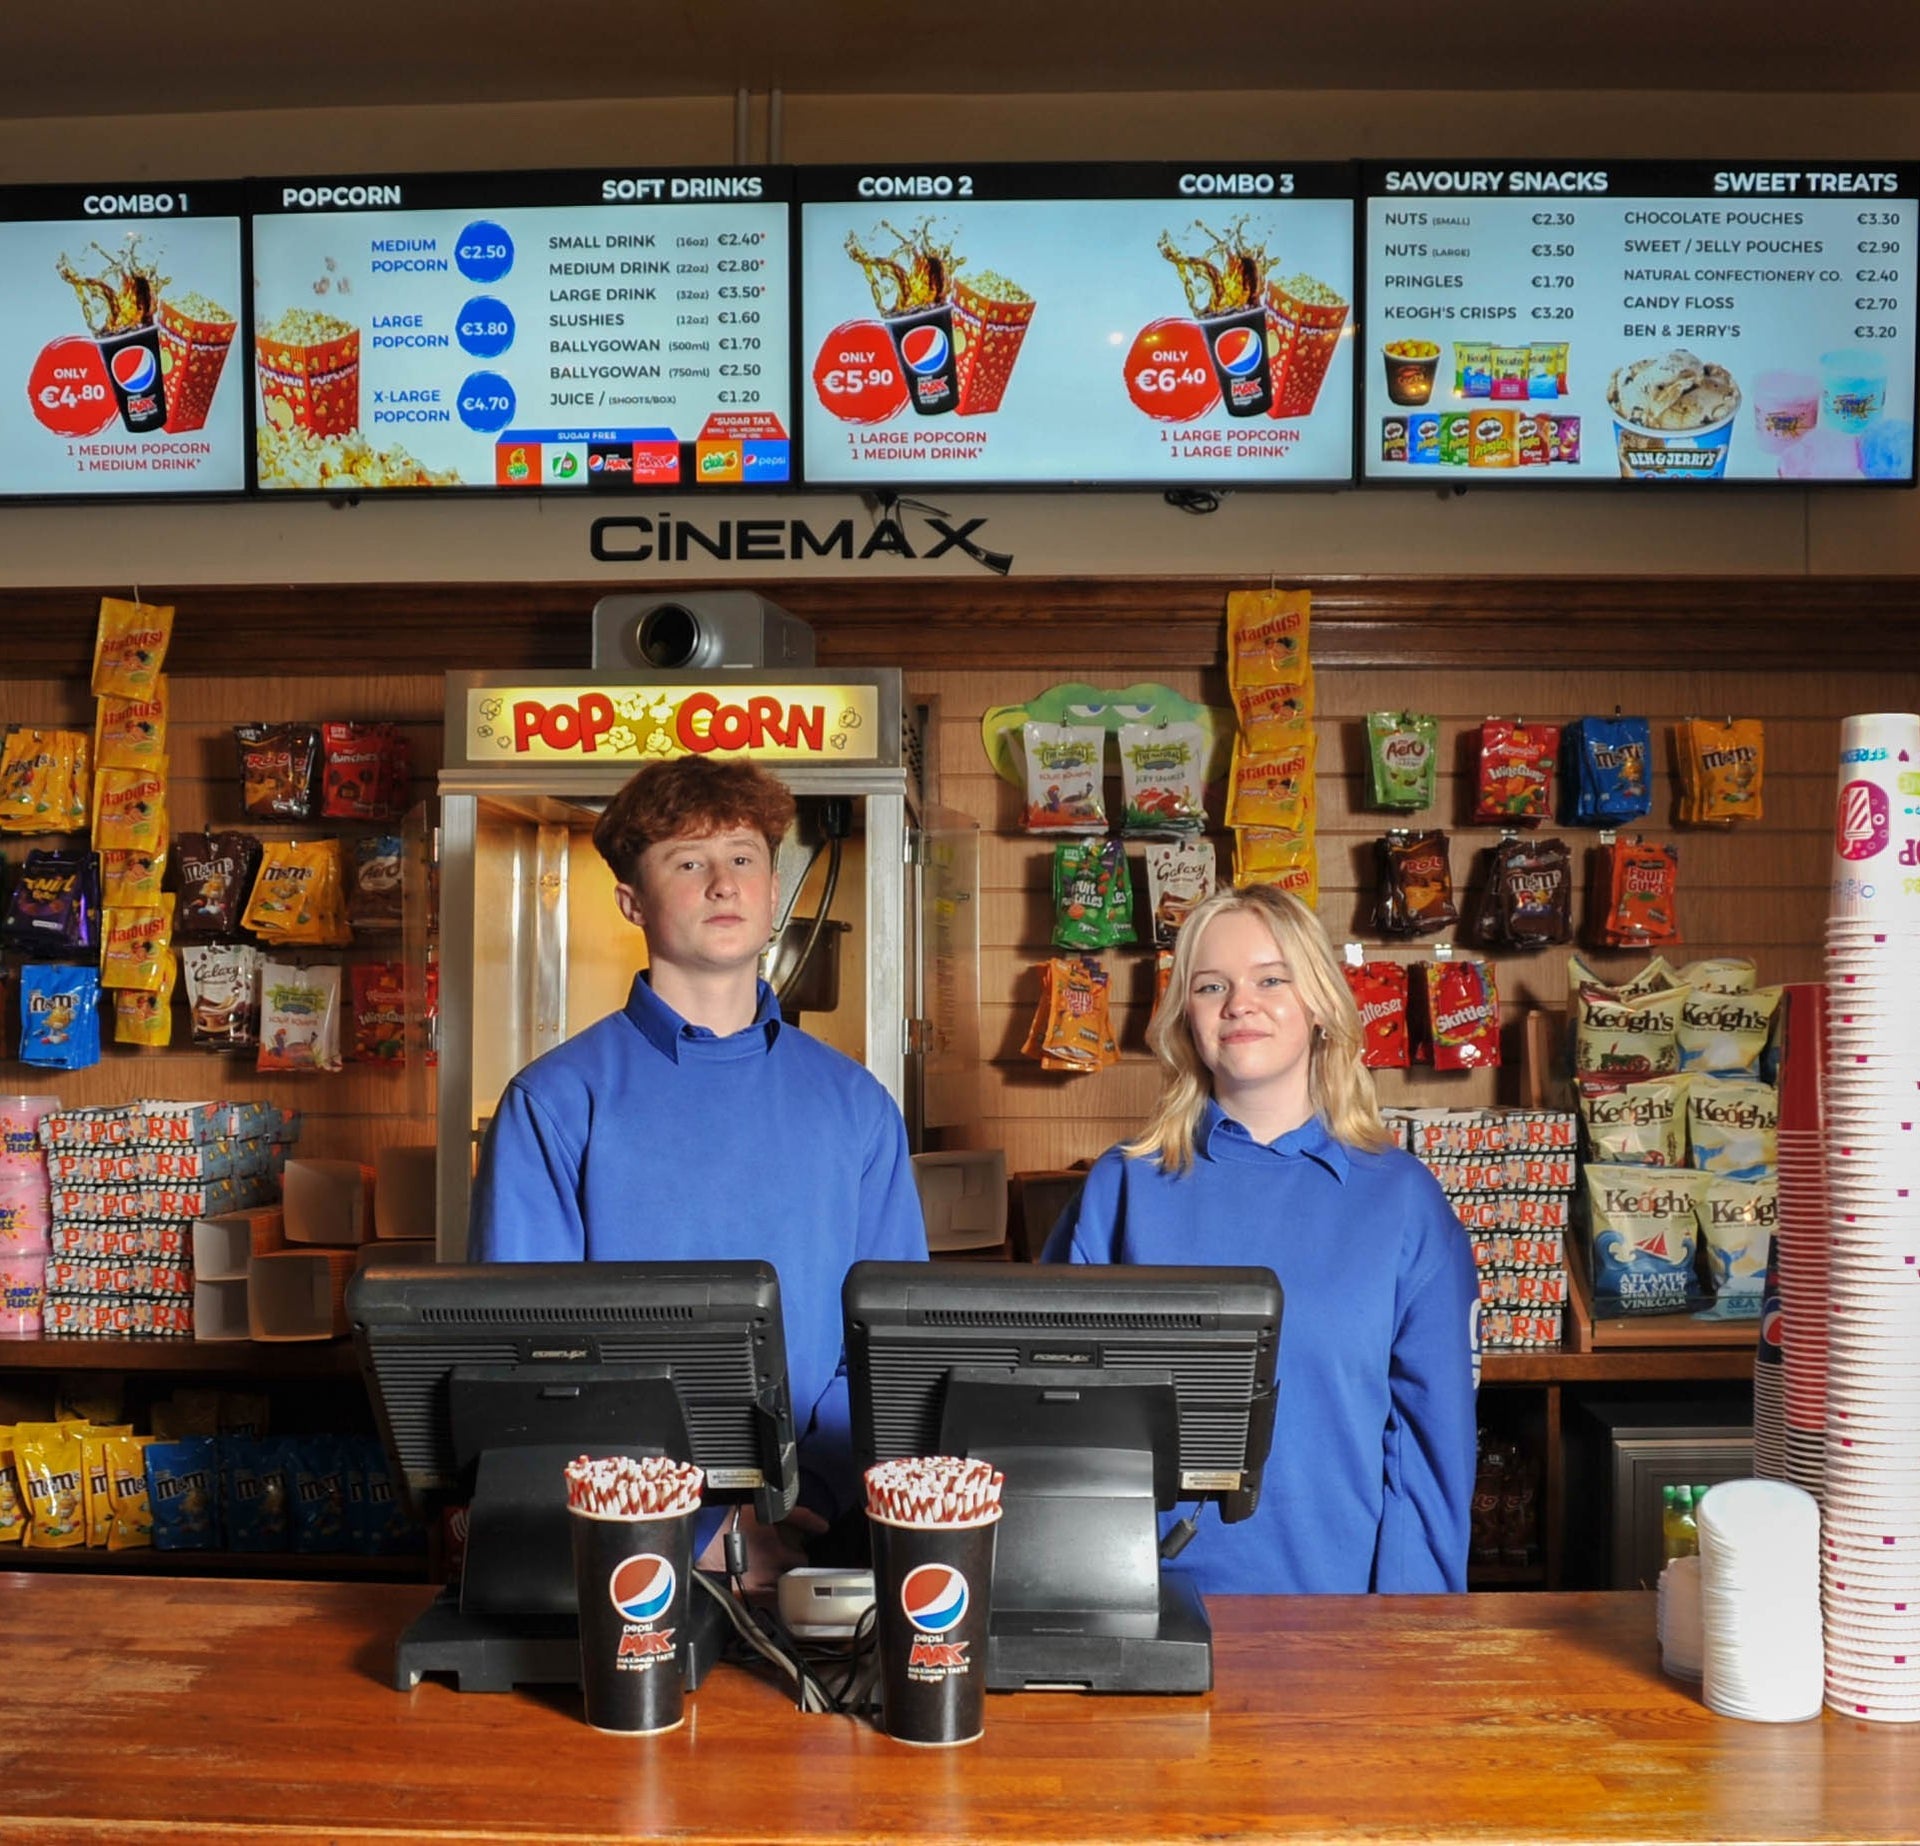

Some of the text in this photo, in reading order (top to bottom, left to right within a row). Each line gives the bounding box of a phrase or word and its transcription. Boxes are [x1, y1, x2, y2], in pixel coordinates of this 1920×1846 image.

[858, 176, 973, 197] COMBO 2
[1180, 174, 1294, 196] COMBO 3
[1386, 172, 1608, 191] SAVOURY SNACKS
[1714, 173, 1898, 192] SWEET TREATS
[602, 178, 762, 199] SOFT DRINKS
[283, 186, 401, 207] POPCORN
[84, 194, 187, 214] COMBO 1
[1385, 213, 1574, 226] NUTS (SMALL) €2.30
[1624, 212, 1900, 225] CHOCOLATE POUCHES €3.30
[372, 240, 436, 252] MEDIUM
[549, 236, 600, 249] SMALL
[606, 235, 656, 248] DRINK
[676, 236, 709, 248] (16oz)
[1624, 239, 1900, 254] SWEET / JELLY POUCHES €2.90
[460, 245, 506, 258] €2.50
[1385, 244, 1574, 257] NUTS (LARGE) €3.50
[372, 260, 448, 272] POPCORN
[550, 263, 615, 275] MEDIUM
[620, 262, 670, 274] DRINK
[676, 264, 709, 274] (22oz)
[1385, 276, 1574, 288] PRINGLES €1.70
[1624, 270, 1898, 282] NATURAL CONFECTIONERY CO. €2.40
[550, 289, 601, 302] LARGE
[606, 288, 656, 300] DRINK
[676, 290, 709, 301] (32oz)
[1624, 297, 1897, 310] CANDY FLOSS €2.70
[550, 312, 760, 326] SLUSHIES (12oz) €1.60
[1384, 306, 1574, 320] KEOGH'S CRISPS €3.20
[372, 316, 423, 328] LARGE
[461, 322, 508, 335] €3.80
[1624, 325, 1896, 338] BEN & JERRY'S €3.20
[373, 336, 449, 348] POPCORN
[550, 338, 761, 354] BALLYGOWAN (500ml) €1.70
[839, 352, 875, 364] ONLY
[1152, 350, 1189, 363] ONLY
[53, 368, 87, 379] ONLY
[550, 364, 761, 379] BALLYGOWAN (750ml) €2.50
[822, 368, 894, 394] €5.90
[1135, 368, 1206, 392] €6.40
[39, 386, 104, 409] €4.80
[374, 390, 440, 402] X-LARGE
[550, 393, 594, 406] JUICE
[598, 392, 605, 406] /
[718, 390, 760, 403] €1.20
[462, 397, 508, 410] €4.70
[374, 410, 450, 422] POPCORN
[752, 416, 770, 425] TAX
[848, 432, 986, 444] 1 LARGE POPCORN
[1160, 430, 1300, 442] 1 LARGE POPCORN
[68, 443, 210, 456] 1 MEDIUM POPCORN
[852, 449, 858, 460] 1
[864, 448, 925, 460] MEDIUM
[1171, 446, 1178, 457] 1
[1183, 446, 1232, 457] LARGE
[78, 460, 84, 471] 1
[89, 460, 147, 470] MEDIUM
[759, 456, 786, 466] pepsi
[513, 692, 824, 752] POP CORN
[1157, 862, 1206, 880] Galaxy
[194, 964, 241, 981] Galaxy
[1620, 1272, 1688, 1283] ATLANTIC
[1620, 1281, 1686, 1293] SEA SALT
[1621, 1298, 1686, 1309] VINEGAR
[623, 1622, 653, 1633] pepsi
[618, 1628, 676, 1656] MAX
[914, 1634, 944, 1644] pepsi
[656, 1652, 674, 1662] TASTE
[910, 1641, 970, 1667] MAX
[948, 1665, 968, 1673] TASTE
